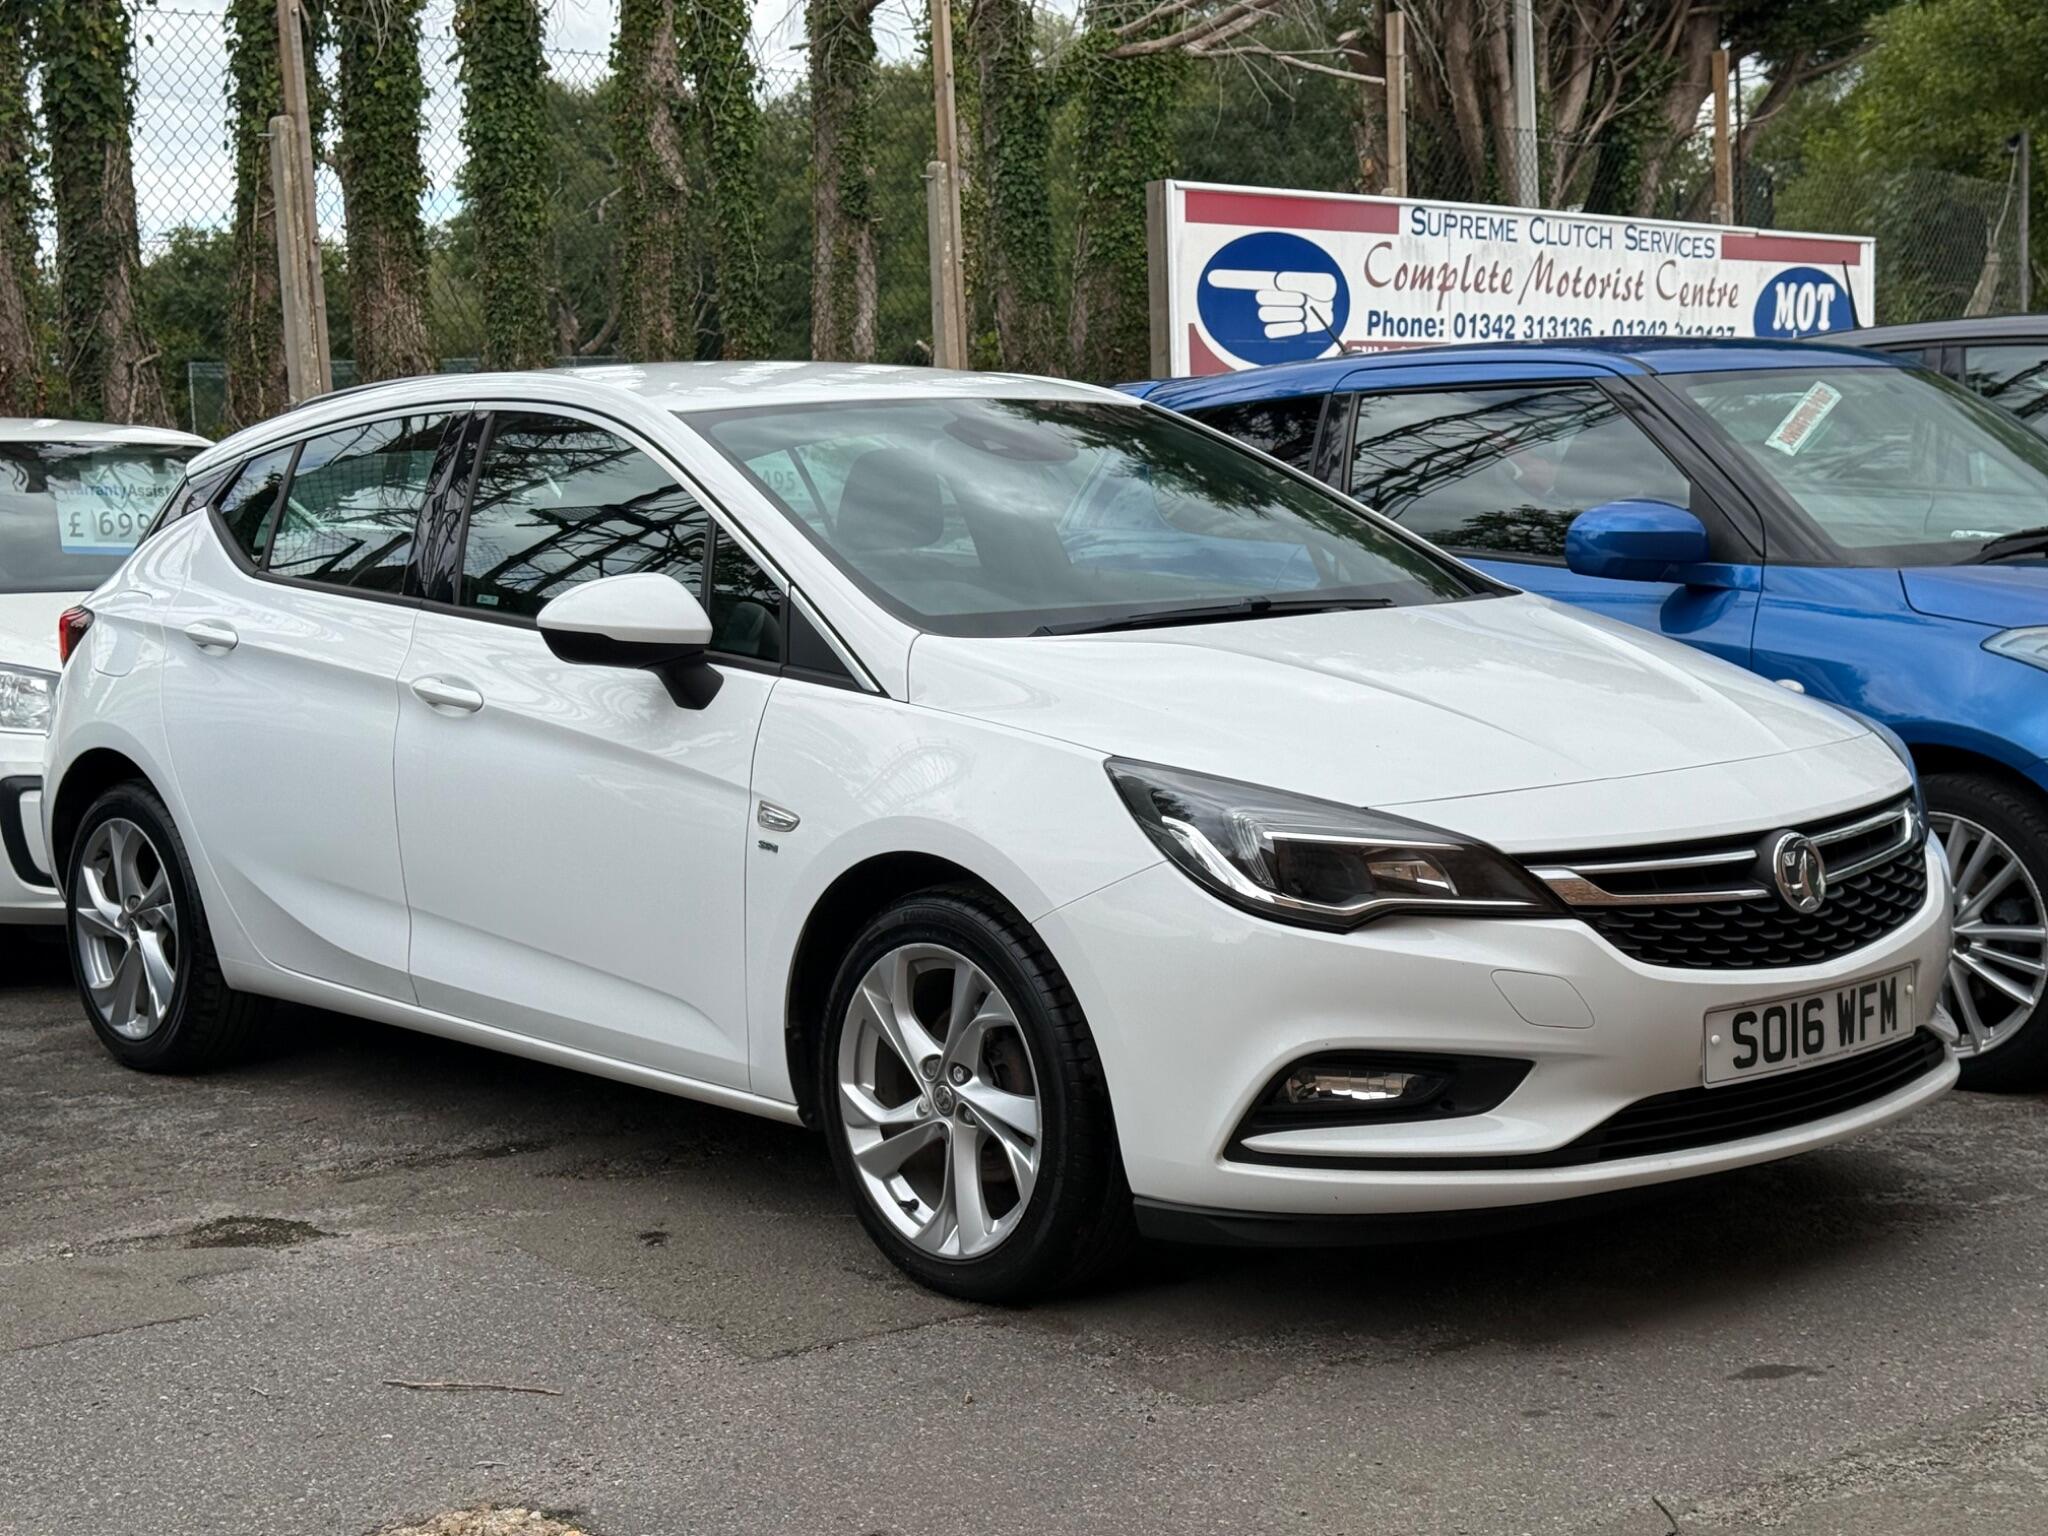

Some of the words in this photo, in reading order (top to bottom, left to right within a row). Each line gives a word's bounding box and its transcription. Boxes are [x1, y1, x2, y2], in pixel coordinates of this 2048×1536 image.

[1411, 206, 1518, 243] SUPREME
[1529, 216, 1613, 250] CLUTCH
[1624, 224, 1716, 259] SERVICES
[1364, 241, 1513, 312] Complete
[1518, 250, 1645, 305] Motorist
[1656, 259, 1739, 309] Centre
[1367, 310, 1445, 338] Phone:
[1453, 312, 1516, 339] 01342
[1523, 315, 1593, 338] 313136
[1772, 281, 1836, 332] MOT
[1732, 997, 1825, 1069] SO16
[1837, 976, 1898, 1047] WFM
